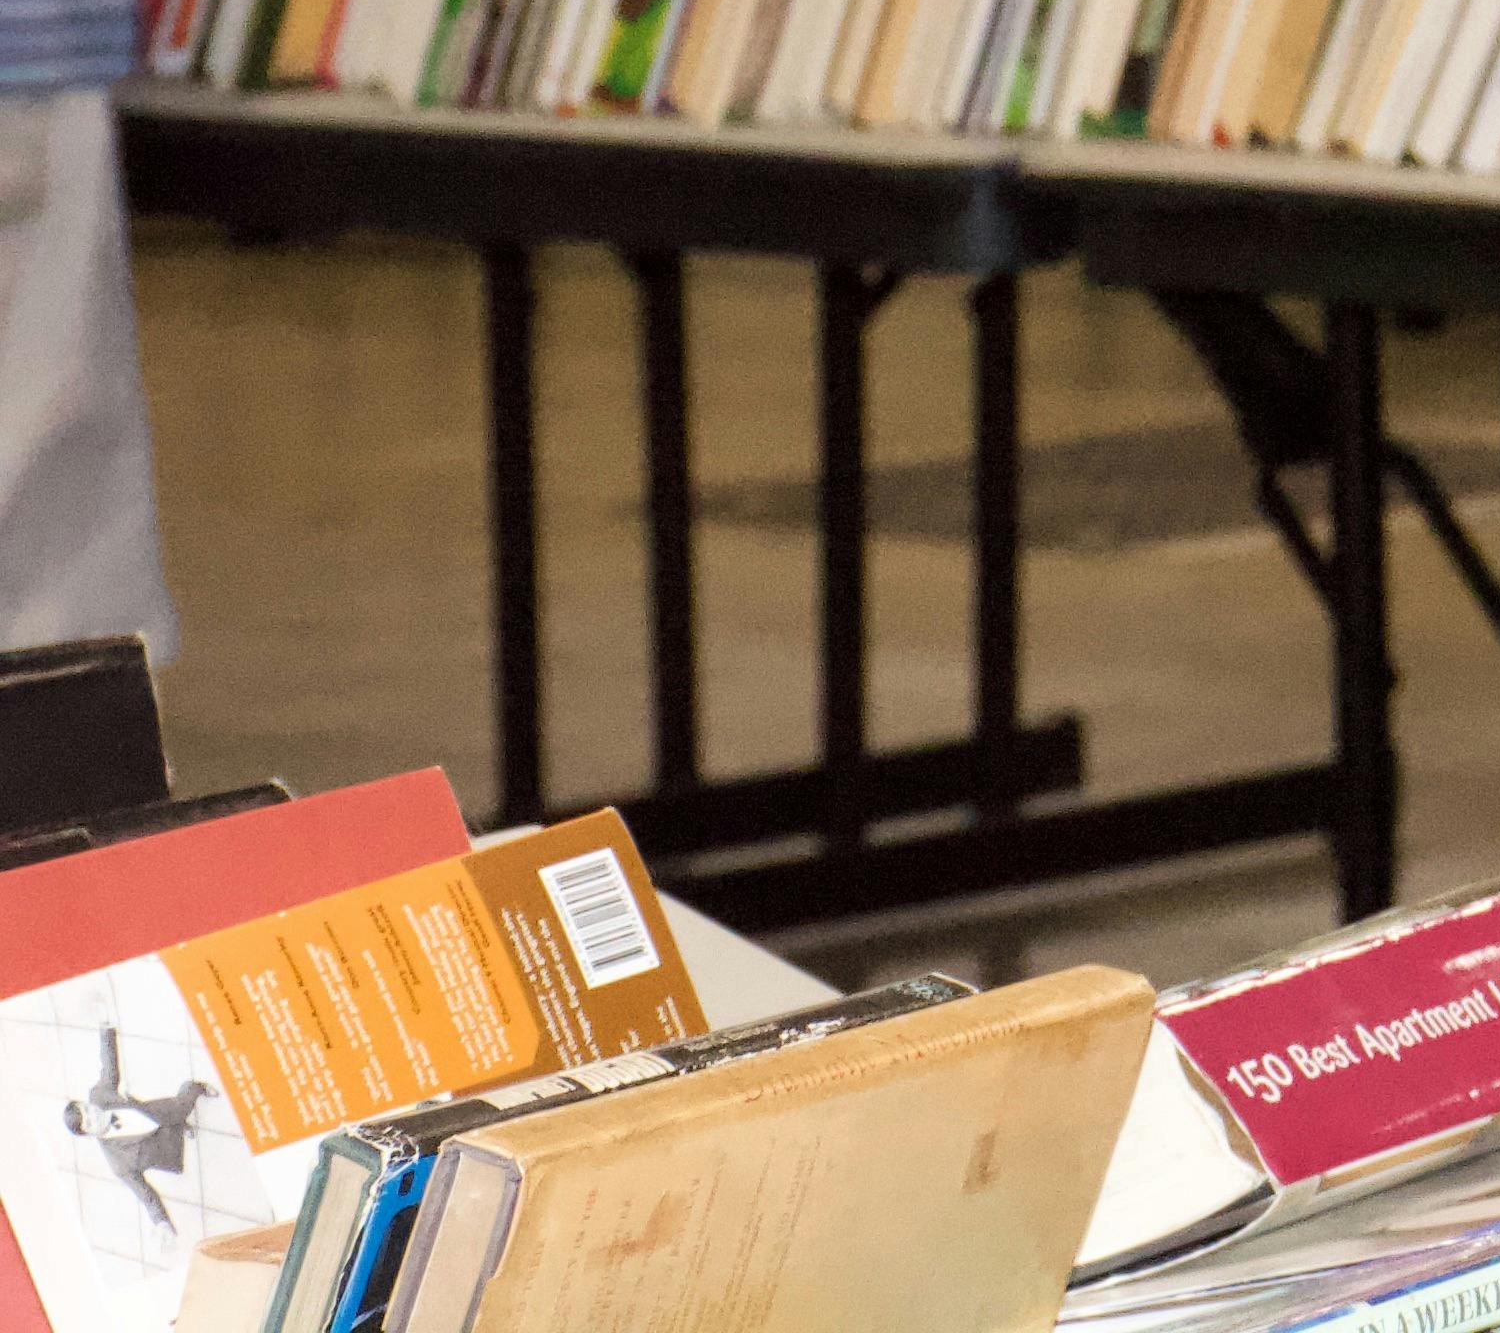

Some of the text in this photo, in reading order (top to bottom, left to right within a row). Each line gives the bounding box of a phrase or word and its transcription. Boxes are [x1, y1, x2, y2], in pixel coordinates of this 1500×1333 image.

[1227, 1052, 1293, 1103] 150
[1286, 1034, 1361, 1080] Best
[1354, 989, 1498, 1061] Apartment
